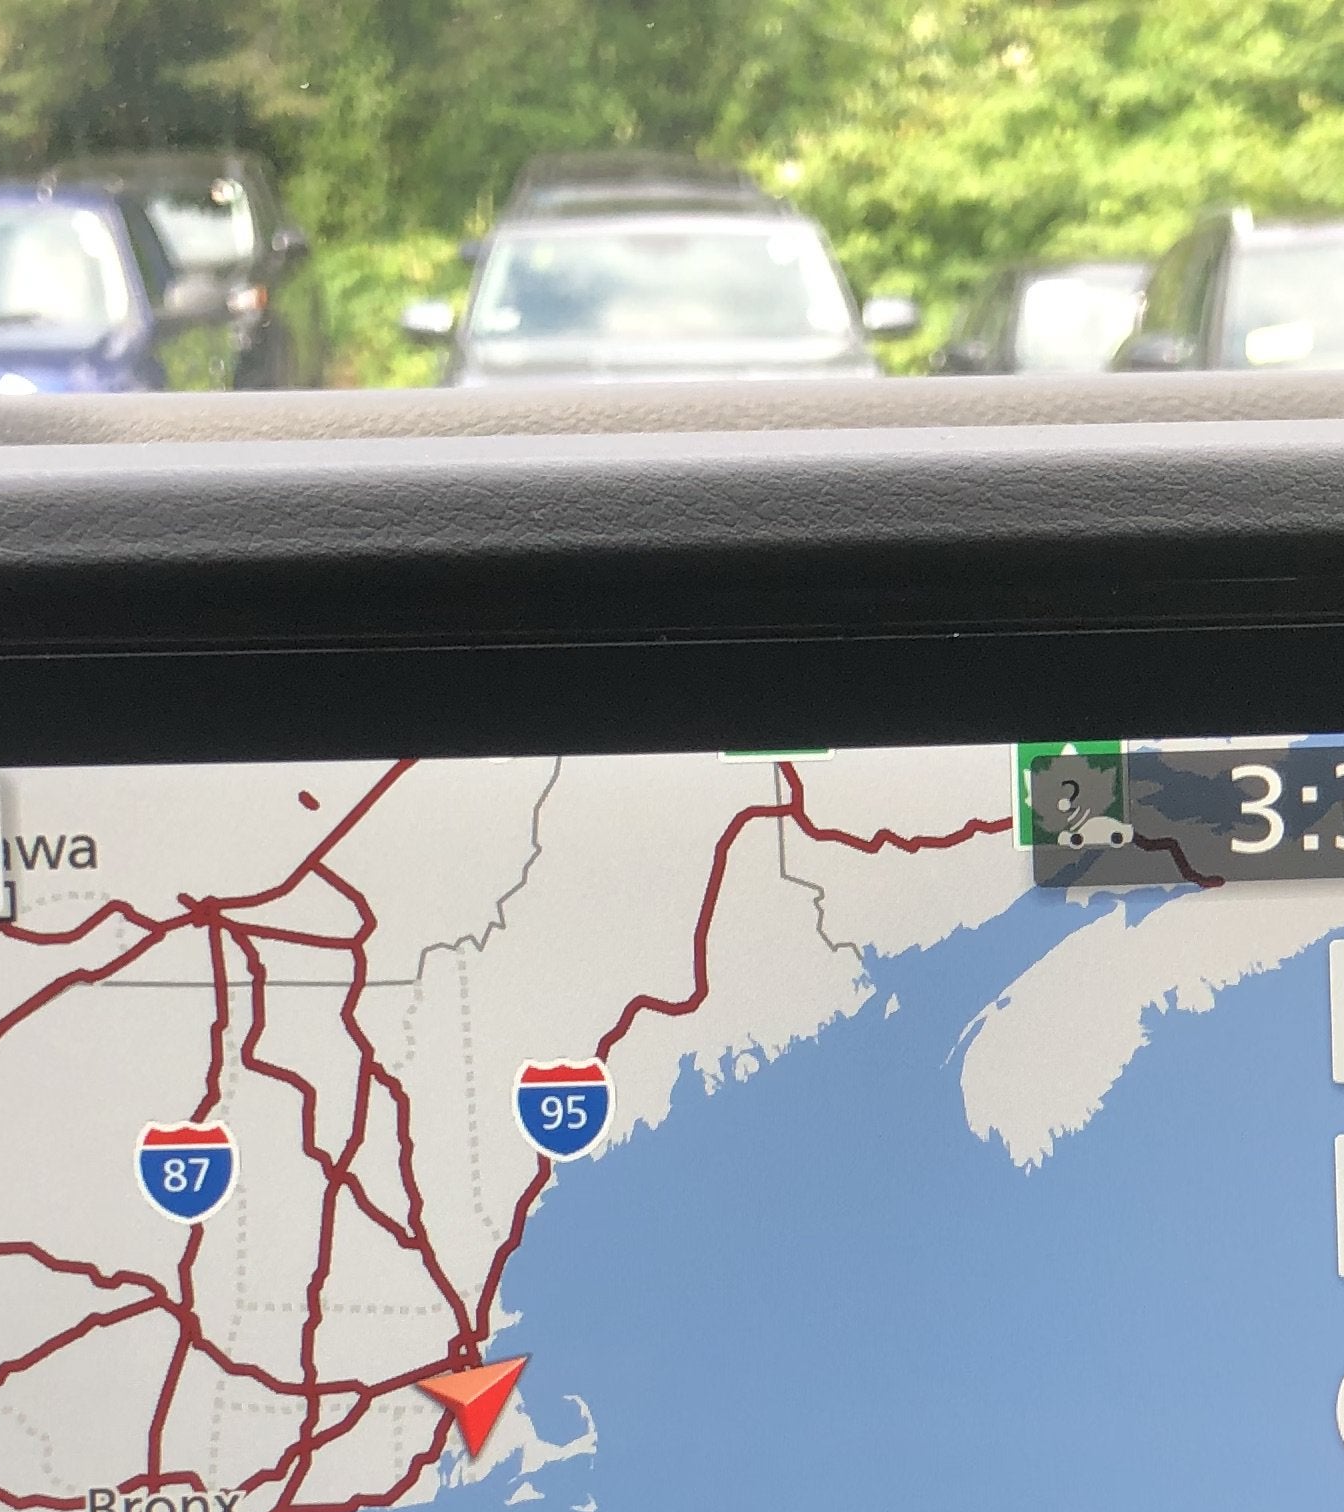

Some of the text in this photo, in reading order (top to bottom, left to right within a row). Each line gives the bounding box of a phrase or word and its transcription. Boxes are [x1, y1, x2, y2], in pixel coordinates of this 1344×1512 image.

[3, 833, 98, 871] wa
[540, 1094, 587, 1130] 95
[163, 1157, 210, 1194] 87
